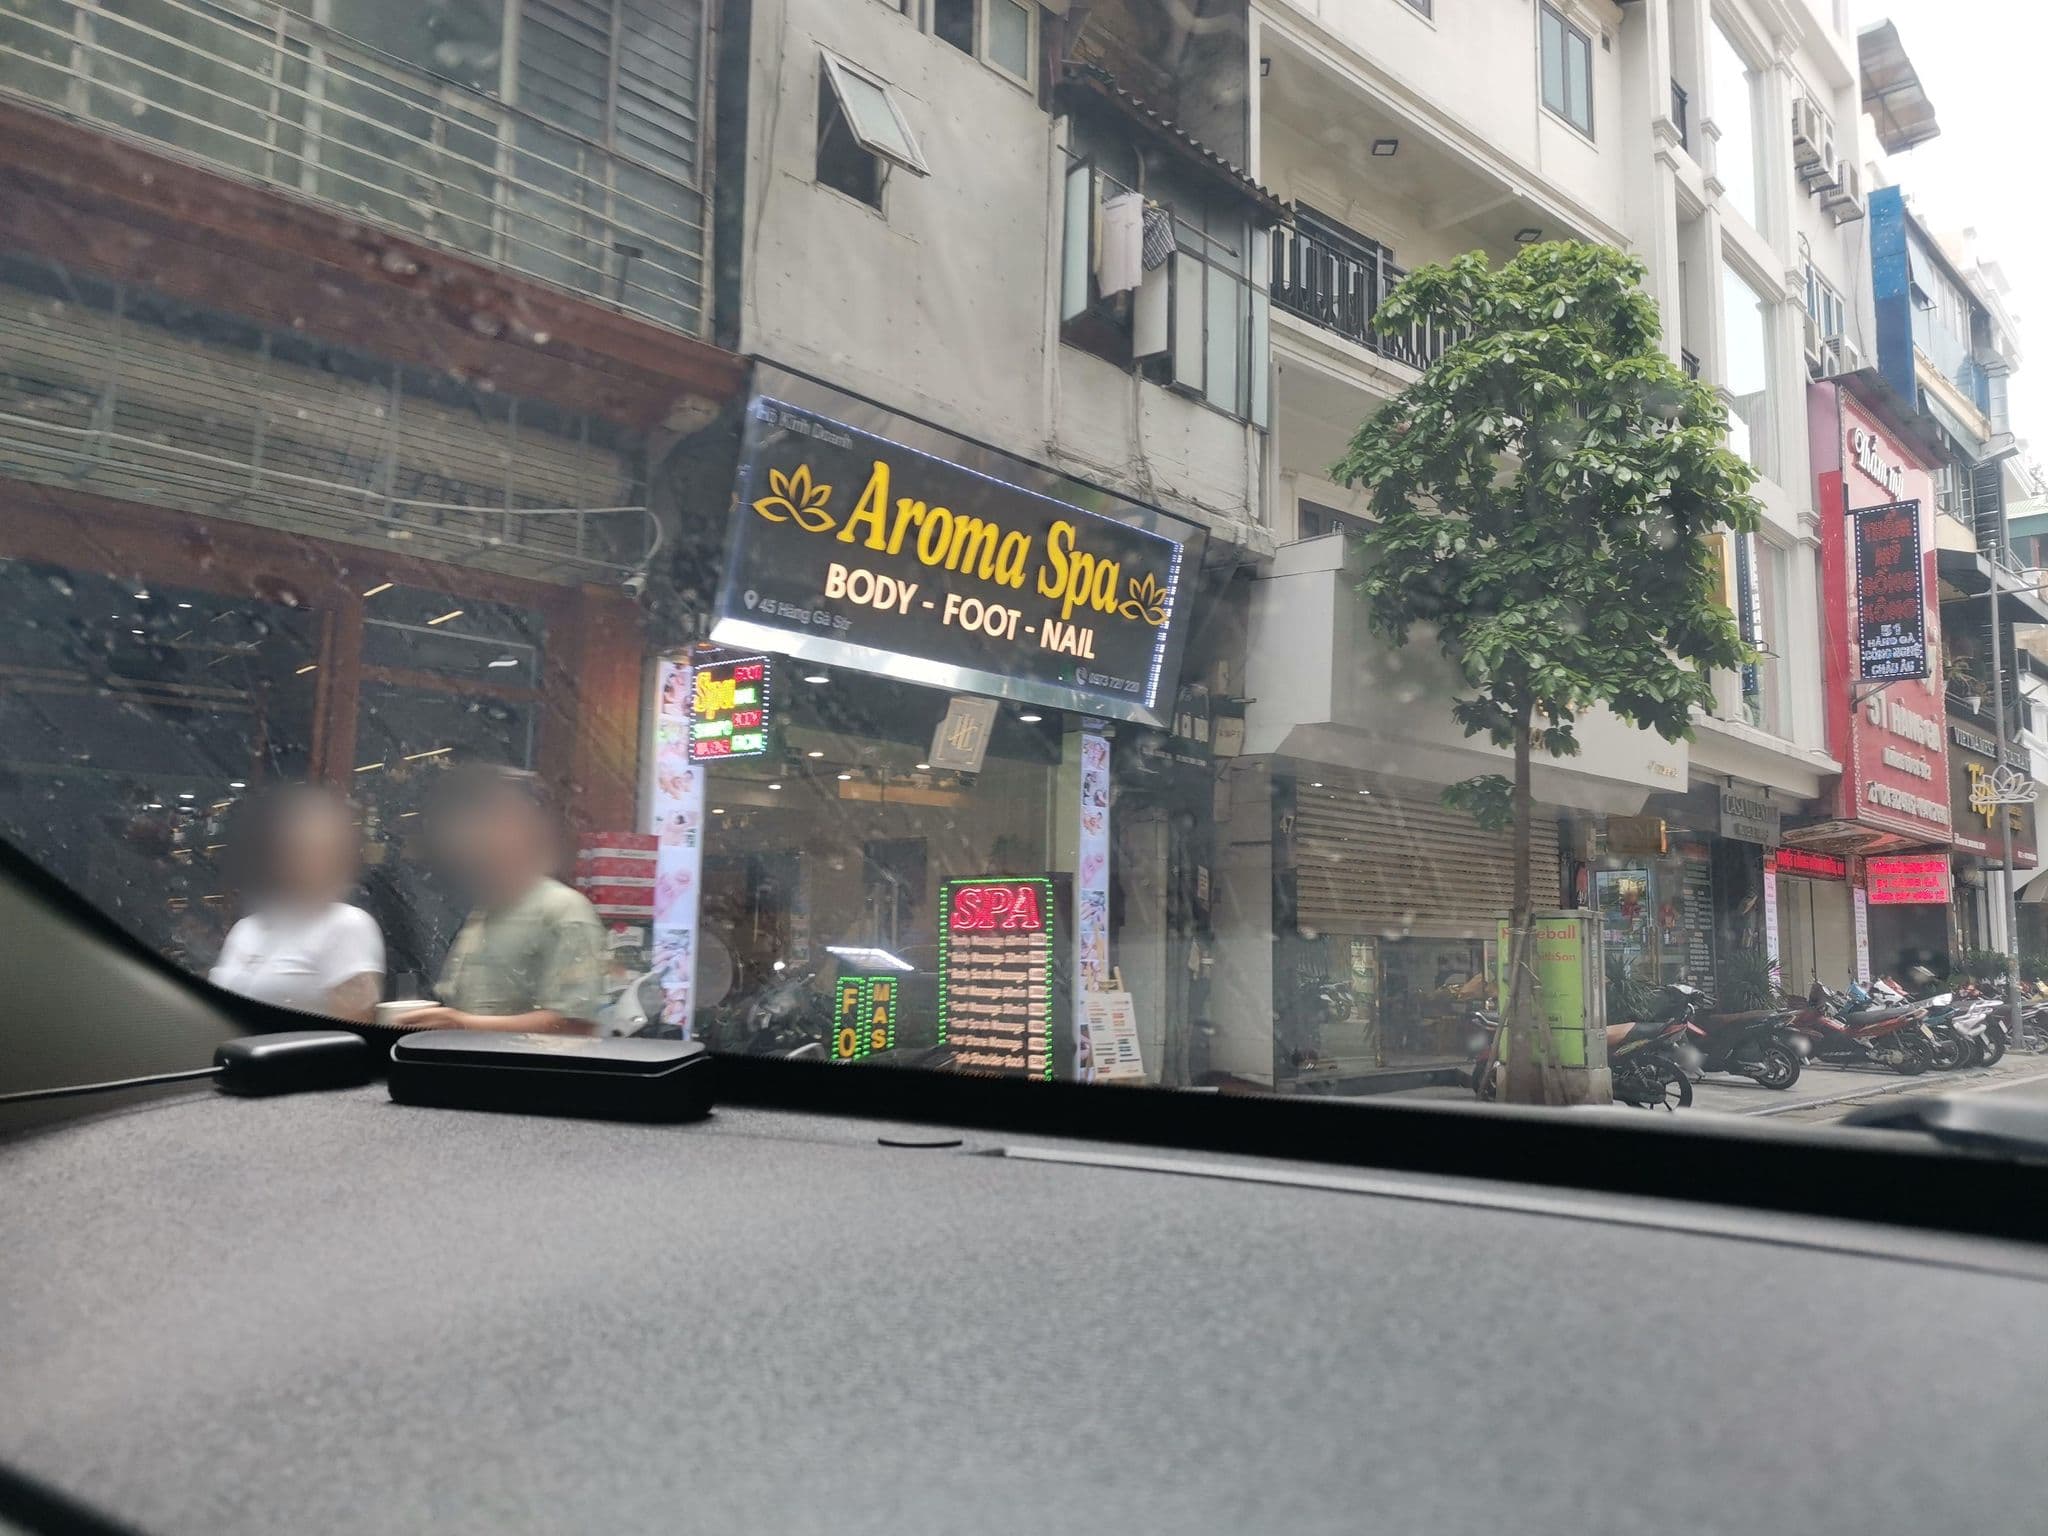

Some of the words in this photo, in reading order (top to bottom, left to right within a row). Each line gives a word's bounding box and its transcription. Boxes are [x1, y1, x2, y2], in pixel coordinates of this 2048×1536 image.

[836, 460, 1032, 589] Aroma
[1037, 520, 1120, 630] Spa
[825, 563, 919, 615] BODY
[943, 593, 1022, 641] FOOT
[1040, 618, 1095, 660] NAIL
[1881, 623, 1902, 637] 51
[951, 886, 1042, 929] SPA
